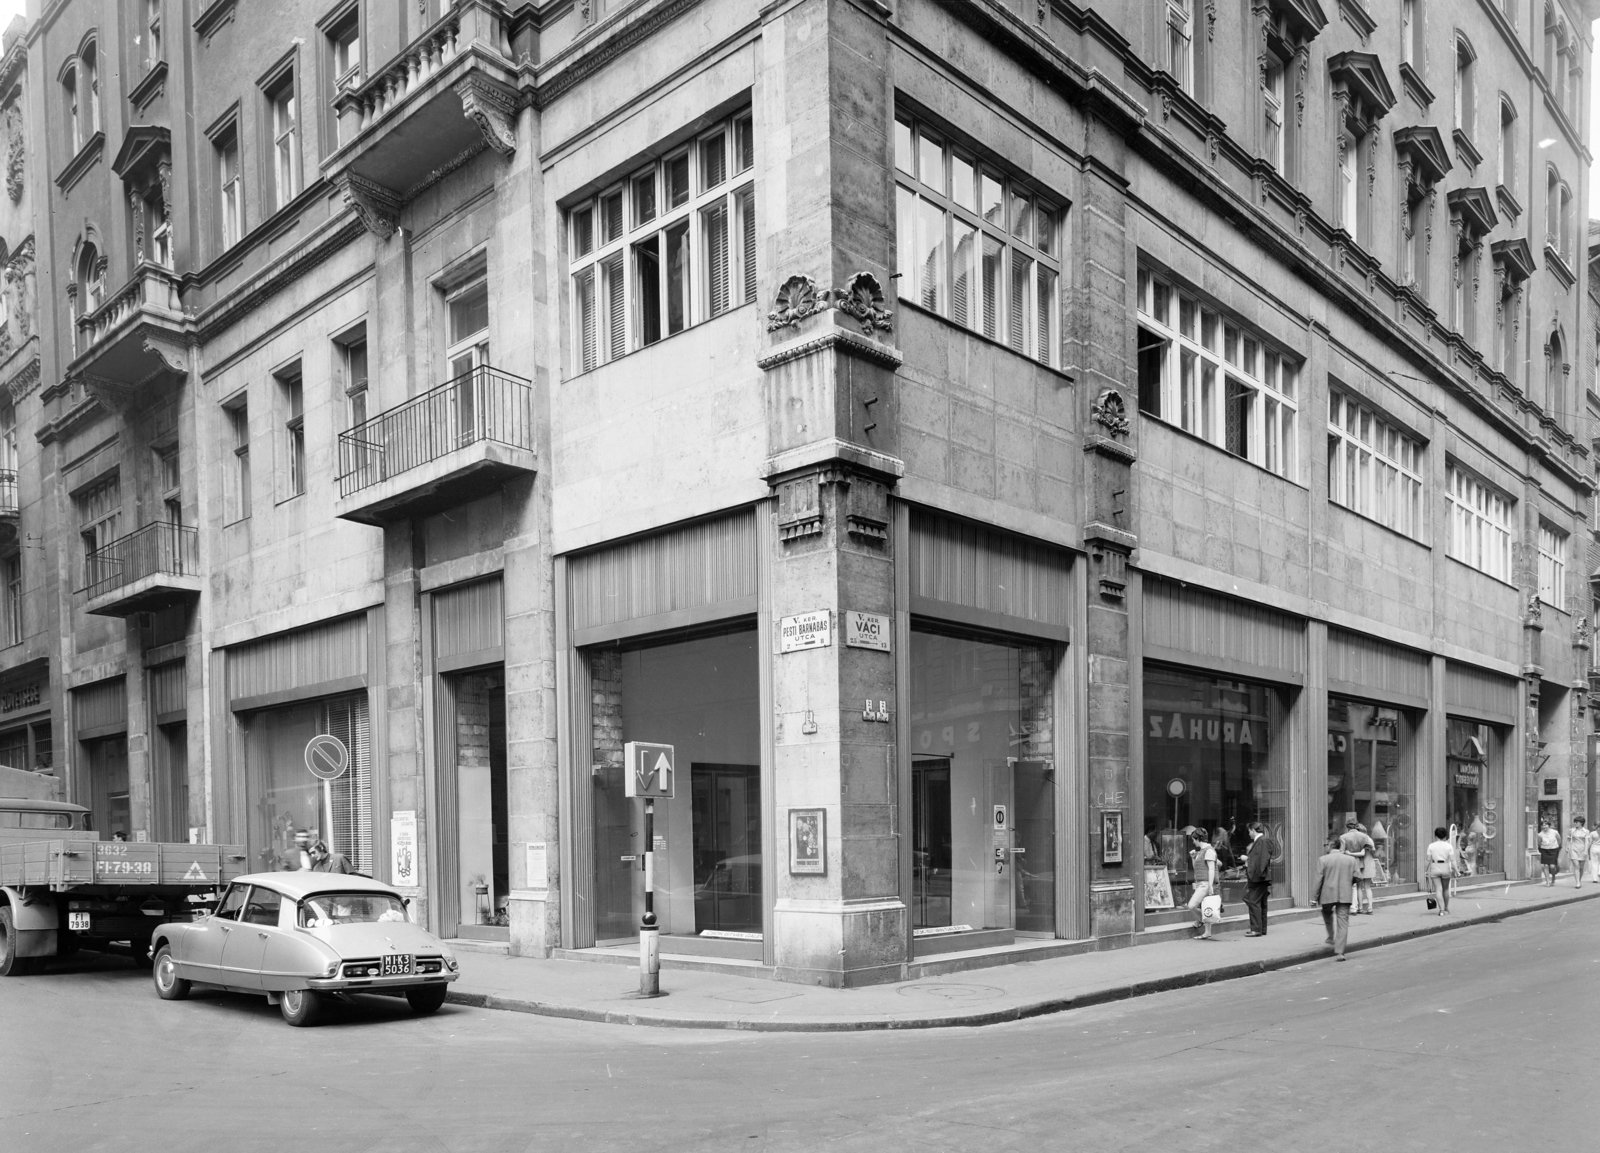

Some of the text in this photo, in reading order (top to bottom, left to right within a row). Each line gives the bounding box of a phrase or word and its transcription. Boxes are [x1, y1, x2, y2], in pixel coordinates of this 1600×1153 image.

[858, 613, 865, 621] V.
[783, 625, 797, 637] PESTI
[855, 621, 880, 635] VÁCI
[795, 634, 815, 642] UTCA
[860, 633, 878, 641] UTCA
[1097, 791, 1125, 806] CHE
[97, 845, 128, 856] 3632
[75, 912, 84, 920] FI
[70, 920, 89, 929] 7938
[385, 964, 410, 975] 5036
